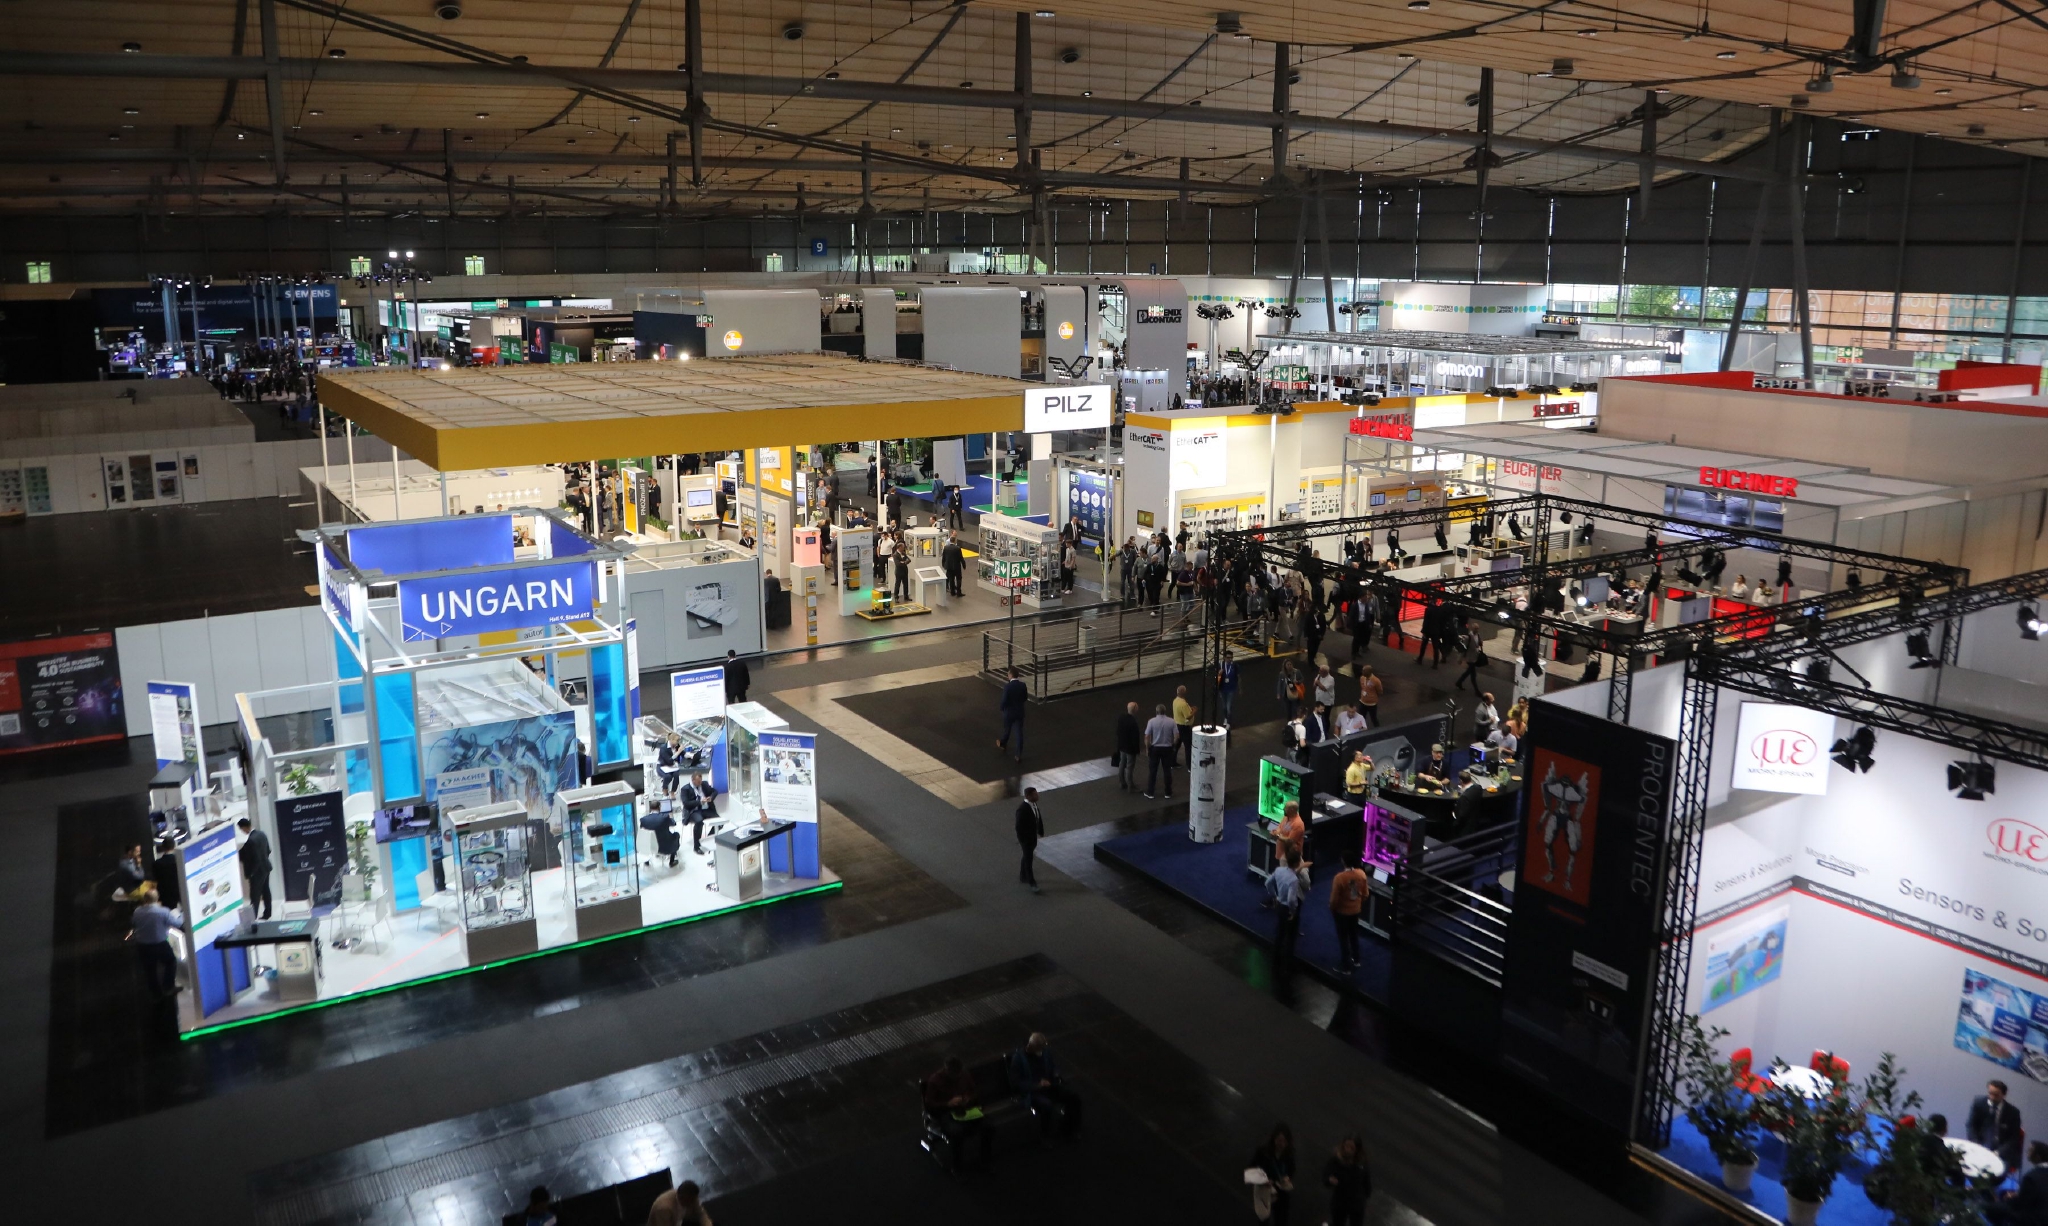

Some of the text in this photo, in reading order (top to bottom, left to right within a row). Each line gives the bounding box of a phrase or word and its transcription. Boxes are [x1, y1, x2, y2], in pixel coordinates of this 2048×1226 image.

[816, 242, 823, 252] 9
[285, 289, 331, 299] SEMENS
[1148, 315, 1182, 324] CONTACT
[1044, 395, 1093, 414] PILZ
[1349, 418, 1414, 442] EUCHNER
[1699, 466, 1799, 498] EUCHNER
[421, 577, 573, 623] UNGARN
[580, 611, 590, 619] A12
[38, 664, 59, 678] 4.0
[452, 772, 486, 783] MACHER
[1630, 741, 1667, 898] PROCENTEC
[1898, 877, 1986, 922] Sensors
[1992, 910, 2009, 930] &
